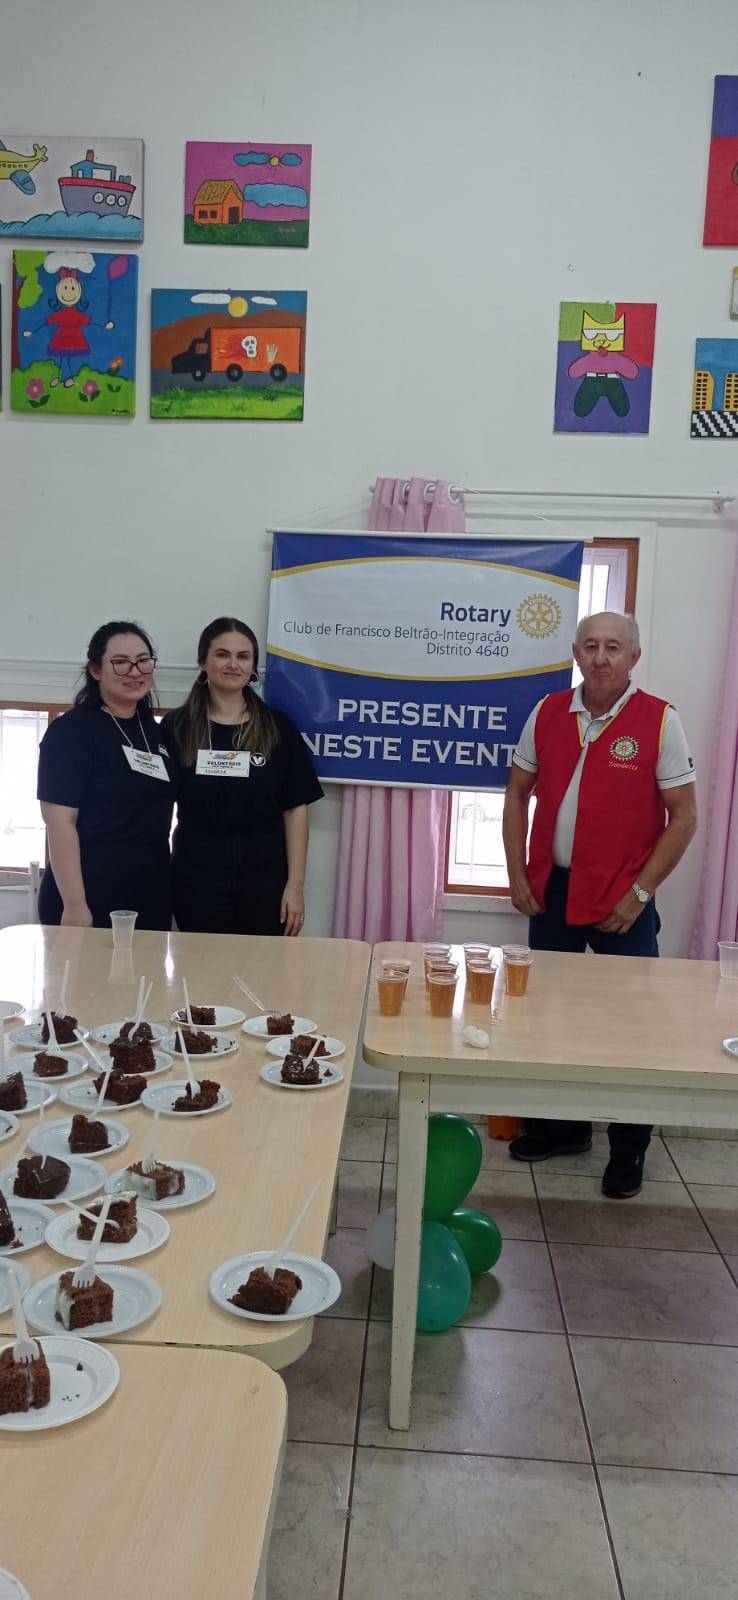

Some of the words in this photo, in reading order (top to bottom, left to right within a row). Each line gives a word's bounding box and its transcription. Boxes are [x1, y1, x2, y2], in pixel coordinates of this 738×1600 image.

[440, 602, 511, 627] Rotary
[283, 620, 313, 634] Club
[316, 622, 332, 636] de
[335, 623, 391, 638] Francisco
[394, 626, 510, 644] Beltrão-Integração
[427, 642, 472, 656] Distrito
[475, 645, 509, 657] 4640
[337, 698, 508, 731] PRESENTE
[300, 732, 402, 761] NESTE
[411, 739, 516, 768] EVENT
